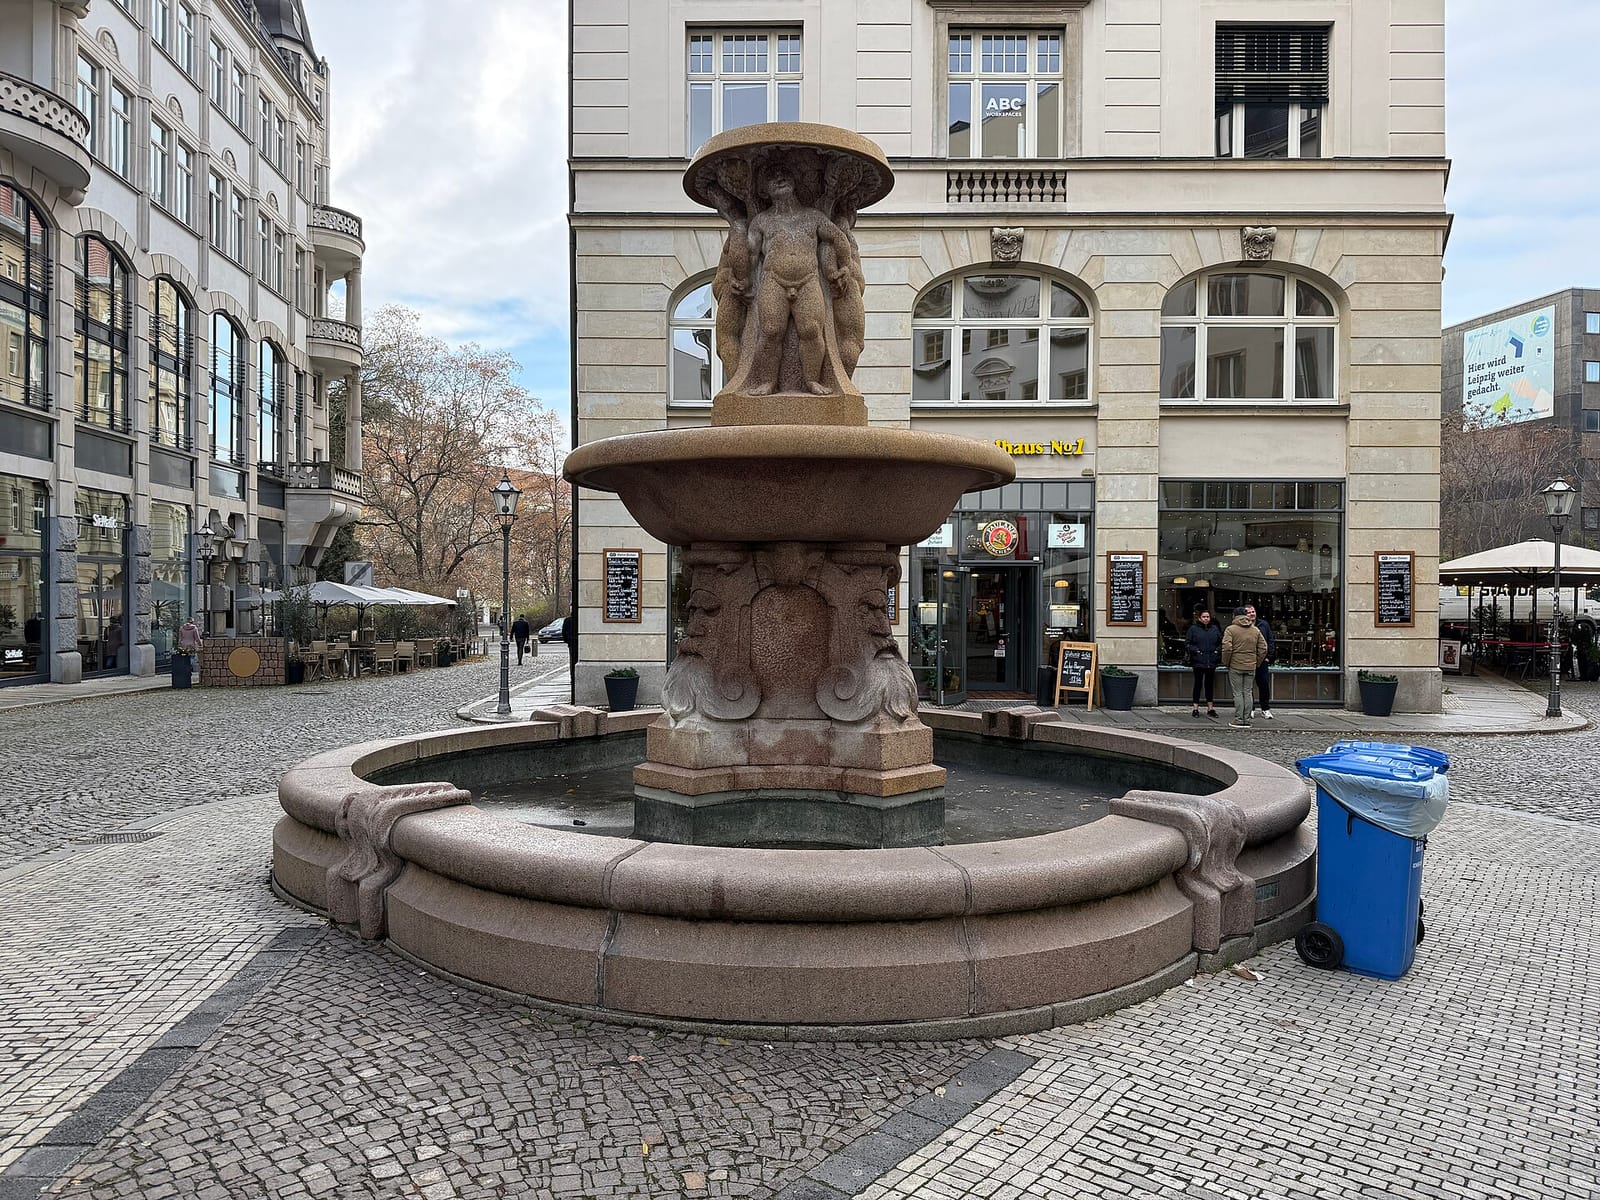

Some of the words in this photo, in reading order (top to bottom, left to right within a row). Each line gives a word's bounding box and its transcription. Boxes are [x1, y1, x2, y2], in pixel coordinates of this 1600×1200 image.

[986, 97, 1022, 110] ABC
[1467, 362, 1486, 373] Hier
[1486, 355, 1507, 368] wird
[1467, 371, 1496, 385] Leipzig
[1497, 365, 1525, 378] weiter
[1467, 382, 1501, 400] gedacht.
